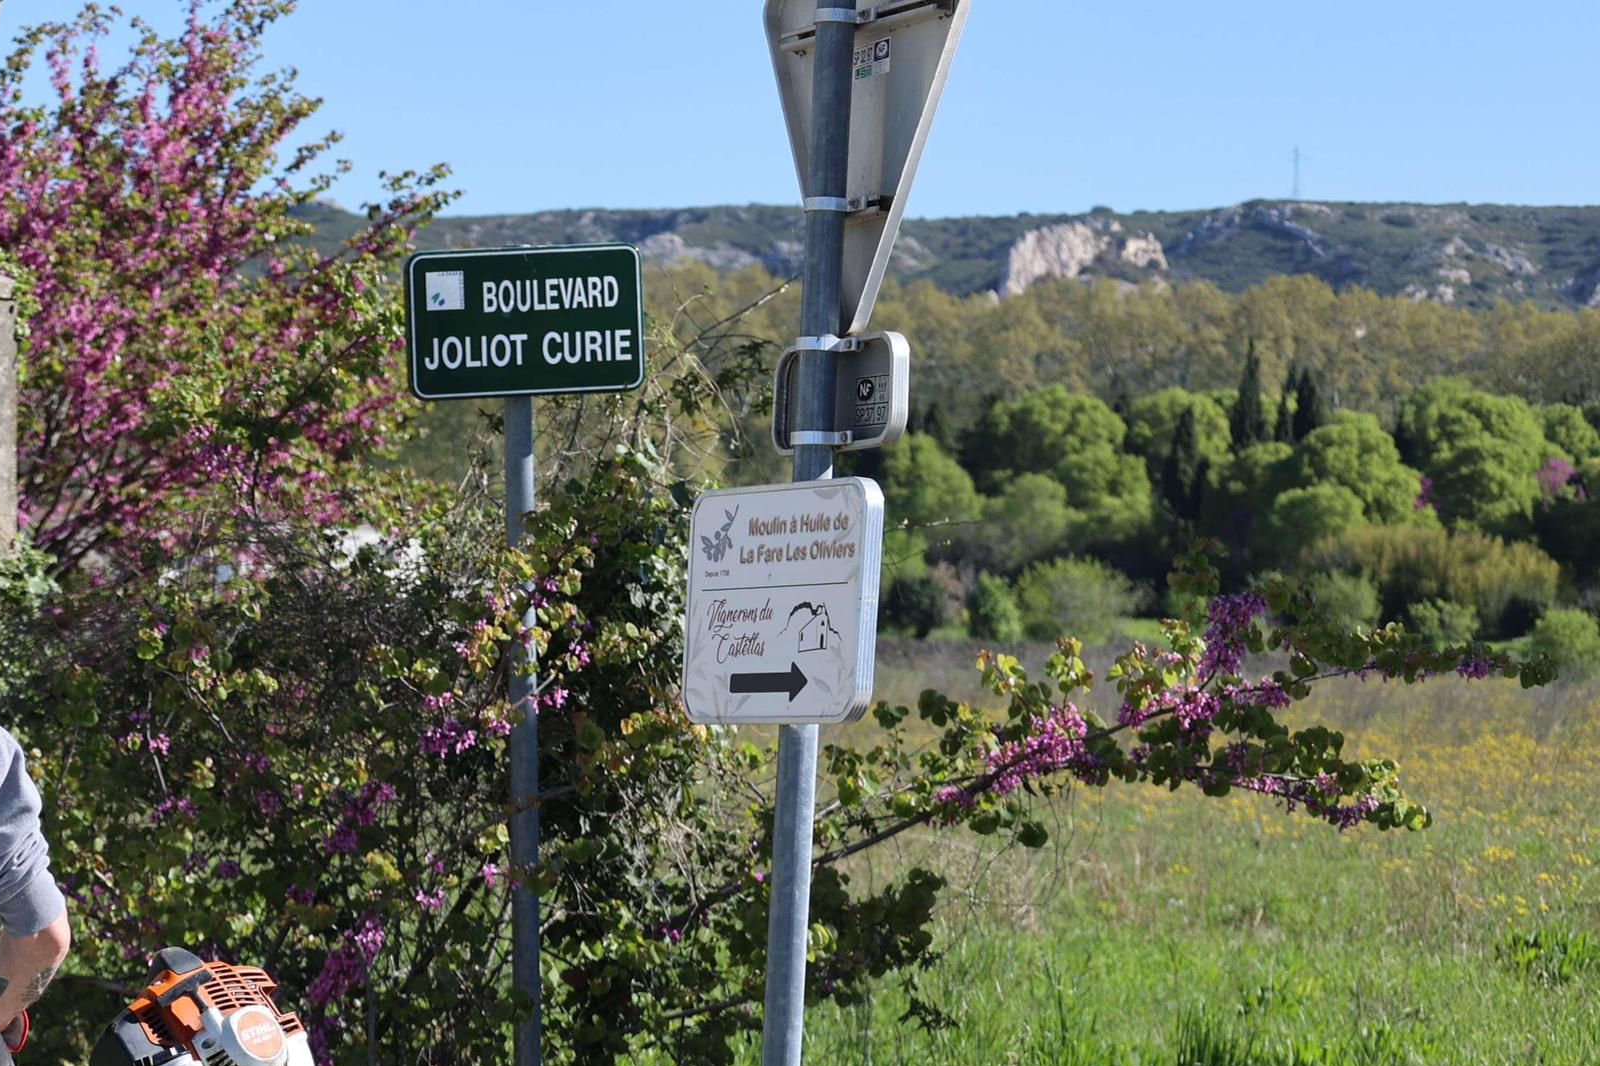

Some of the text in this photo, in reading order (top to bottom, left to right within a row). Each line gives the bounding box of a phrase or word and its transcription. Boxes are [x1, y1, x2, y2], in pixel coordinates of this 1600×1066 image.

[482, 275, 619, 314] BOULEVARD
[424, 328, 633, 371] JOLIOT CURIE
[859, 383, 872, 397] NF
[748, 510, 849, 537] Moulin à Huile de
[739, 539, 856, 564] La Fare Les Oliviers
[706, 597, 773, 633] Vignerons du
[711, 632, 765, 664] Castellas
[240, 1021, 277, 1041] STIHL
